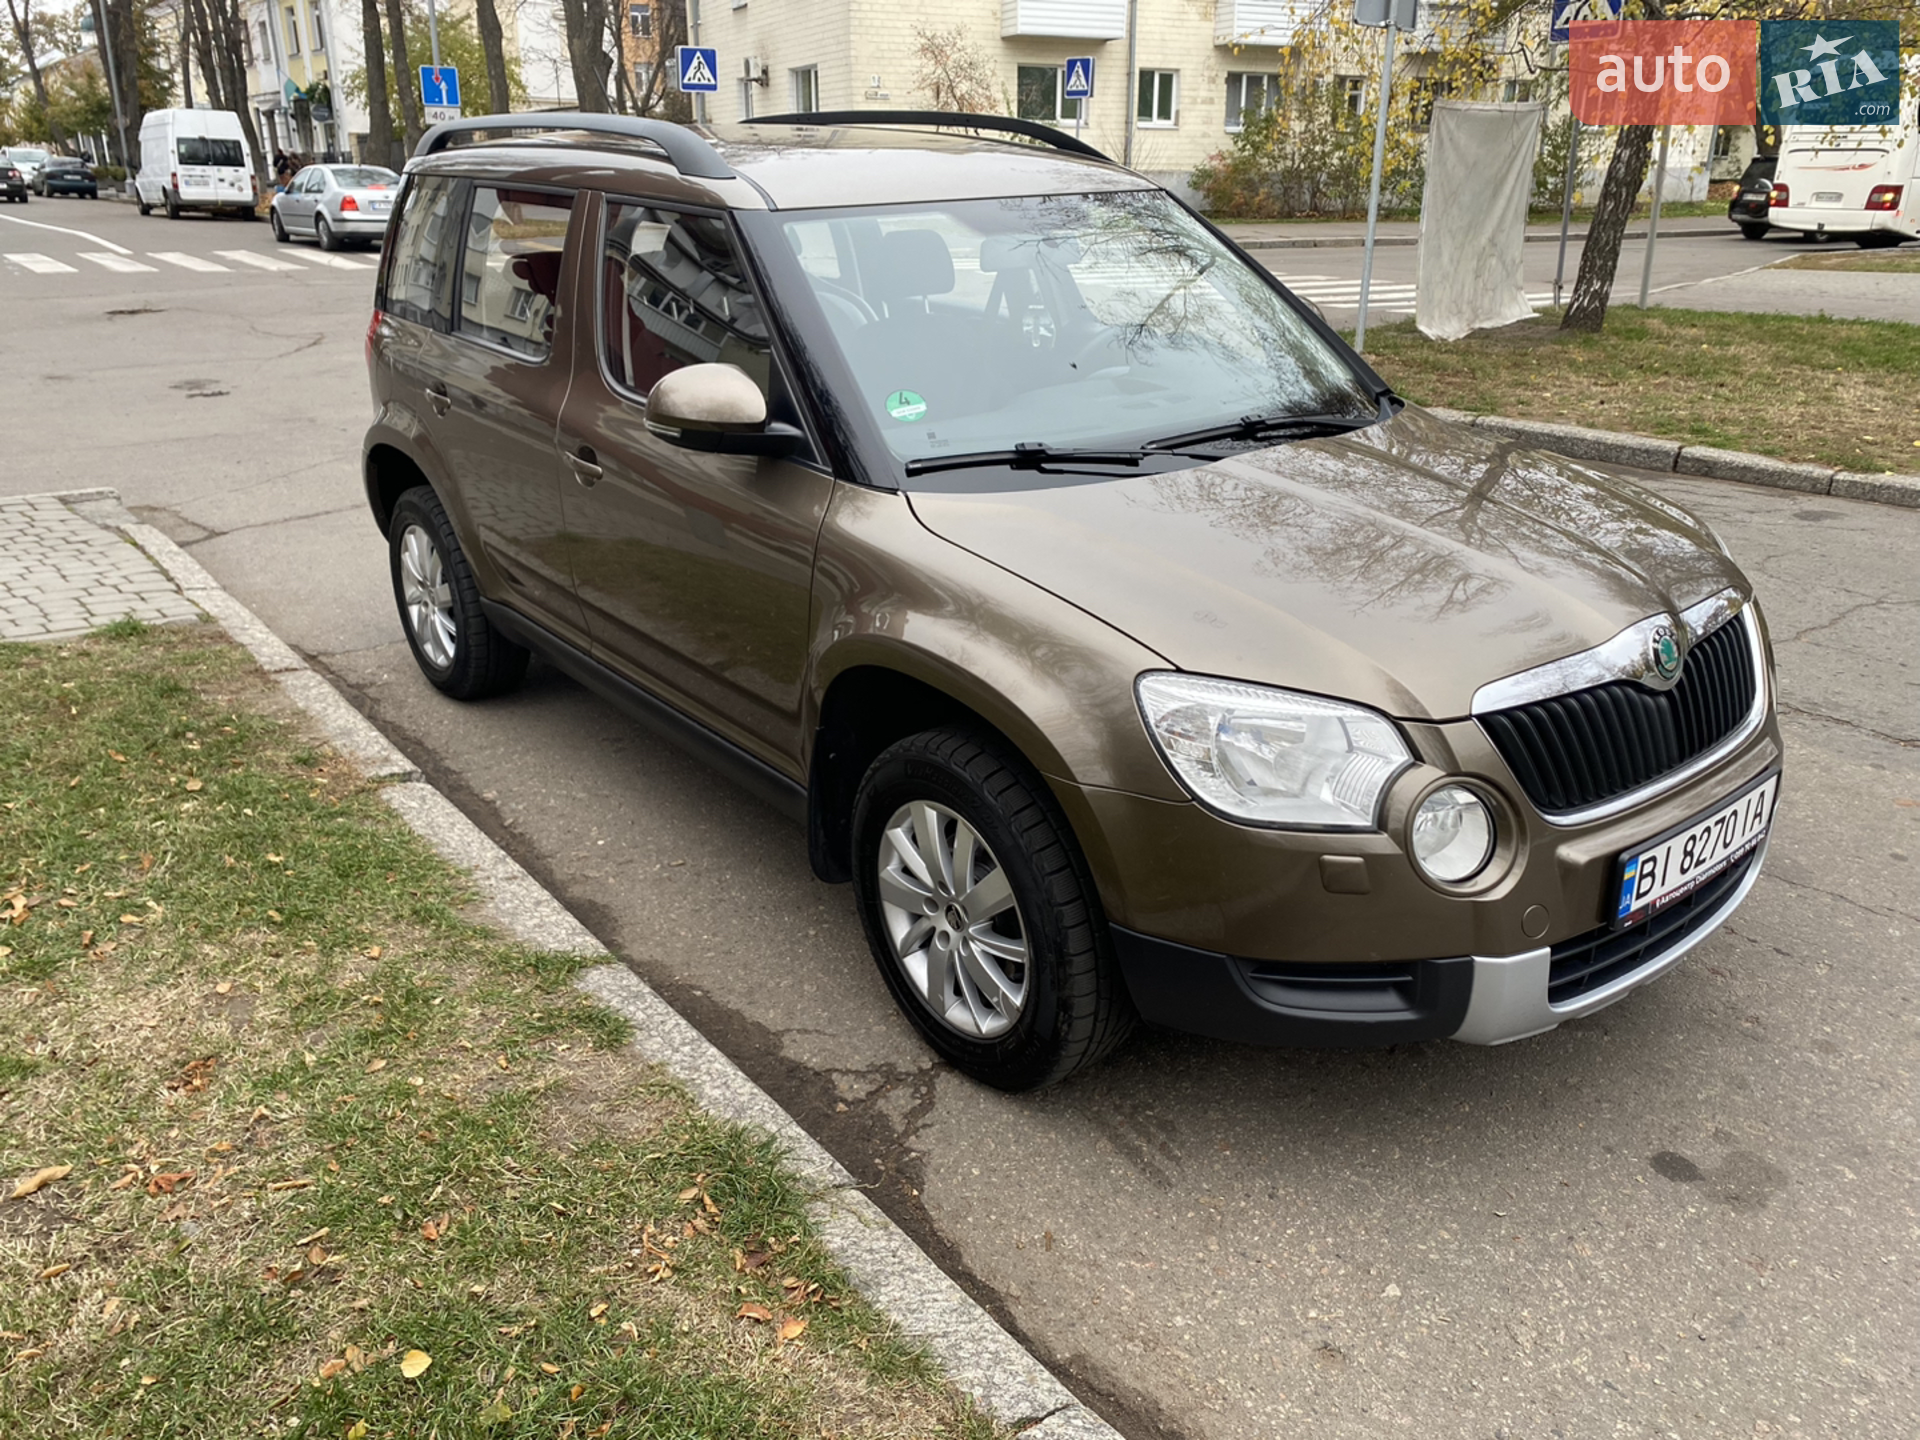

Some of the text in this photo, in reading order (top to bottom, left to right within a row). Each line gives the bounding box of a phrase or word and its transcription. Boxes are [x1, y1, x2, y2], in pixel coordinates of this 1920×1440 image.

[432, 111, 446, 121] 40
[899, 391, 911, 406] 4
[1635, 845, 1672, 901] BI
[1679, 809, 1739, 876] 8270
[1741, 789, 1767, 838] IA
